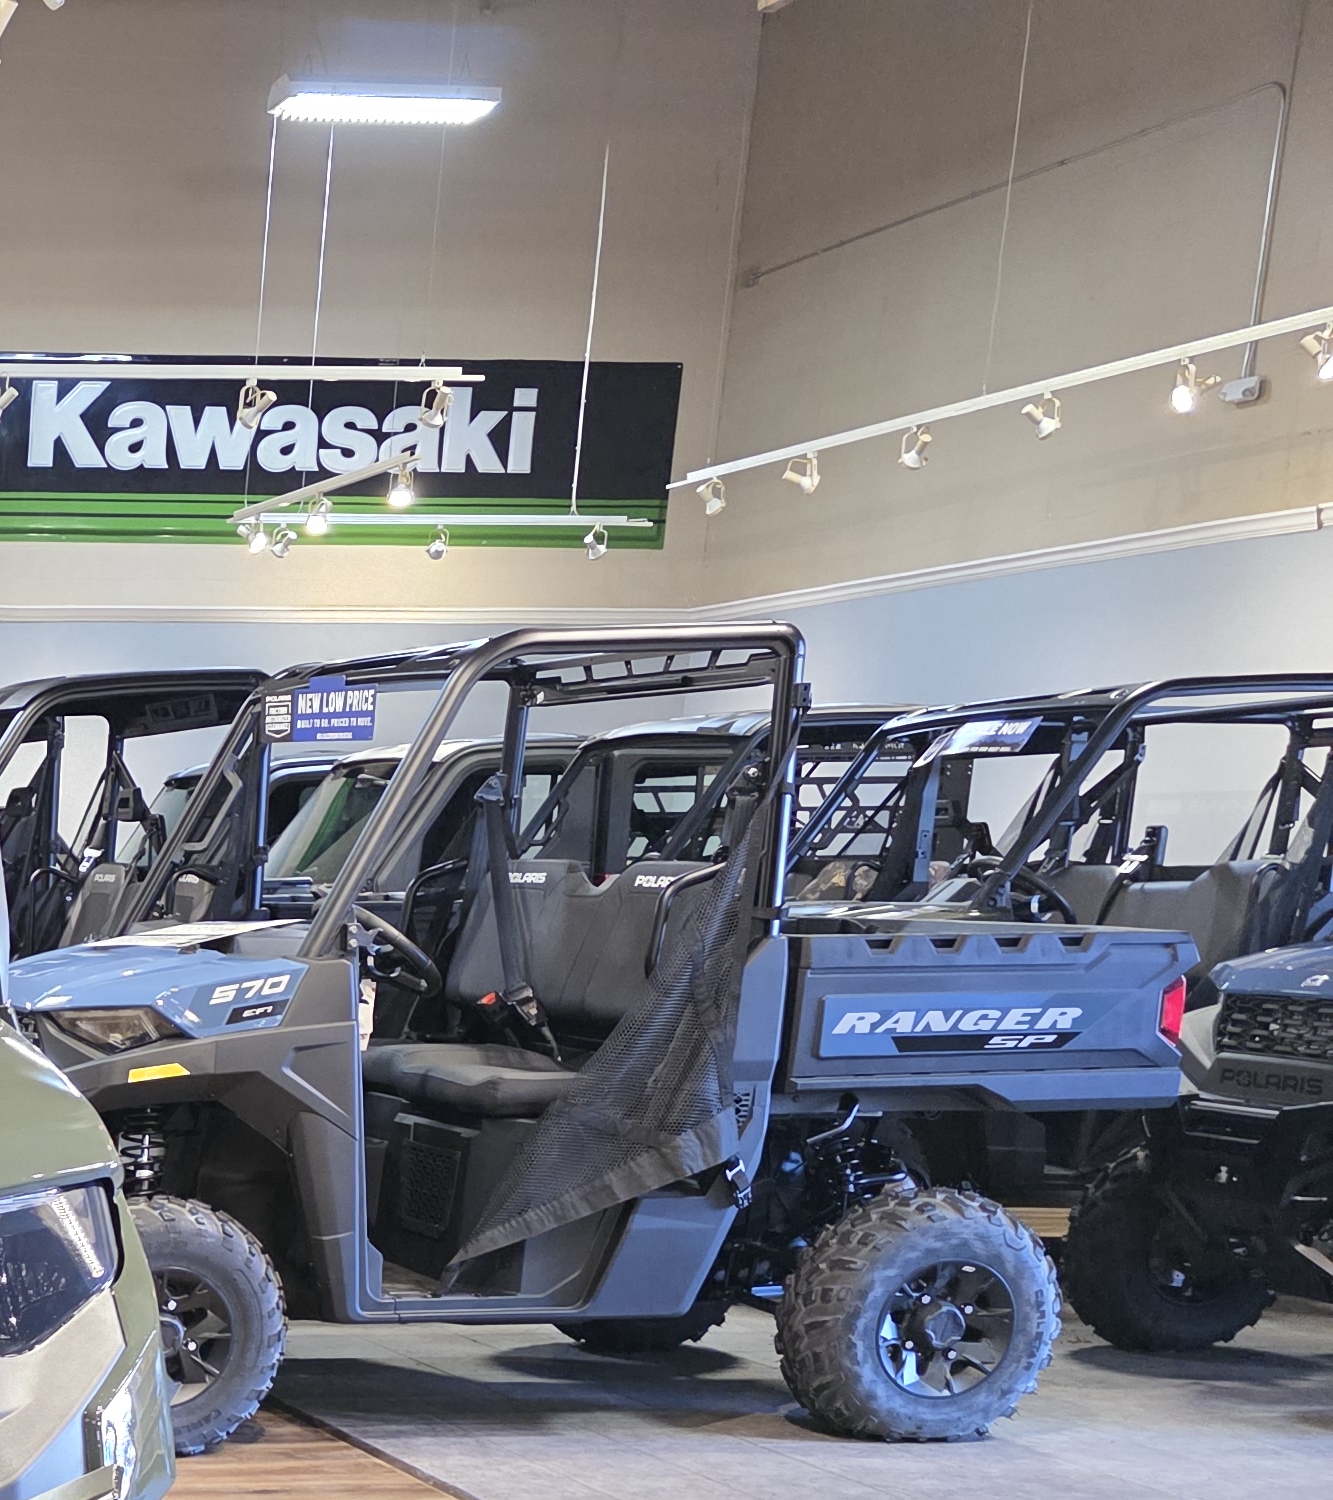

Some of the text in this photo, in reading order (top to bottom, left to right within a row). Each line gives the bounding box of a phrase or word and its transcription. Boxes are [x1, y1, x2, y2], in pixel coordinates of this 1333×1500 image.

[27, 380, 539, 474] Kawasaki
[297, 689, 375, 714] NEW LOW PRICE
[209, 975, 291, 1005] 570
[242, 1005, 273, 1018] EFI
[831, 1007, 1083, 1035] RANGER
[983, 1034, 1059, 1049] SP
[1219, 1068, 1323, 1095] POLARIS
